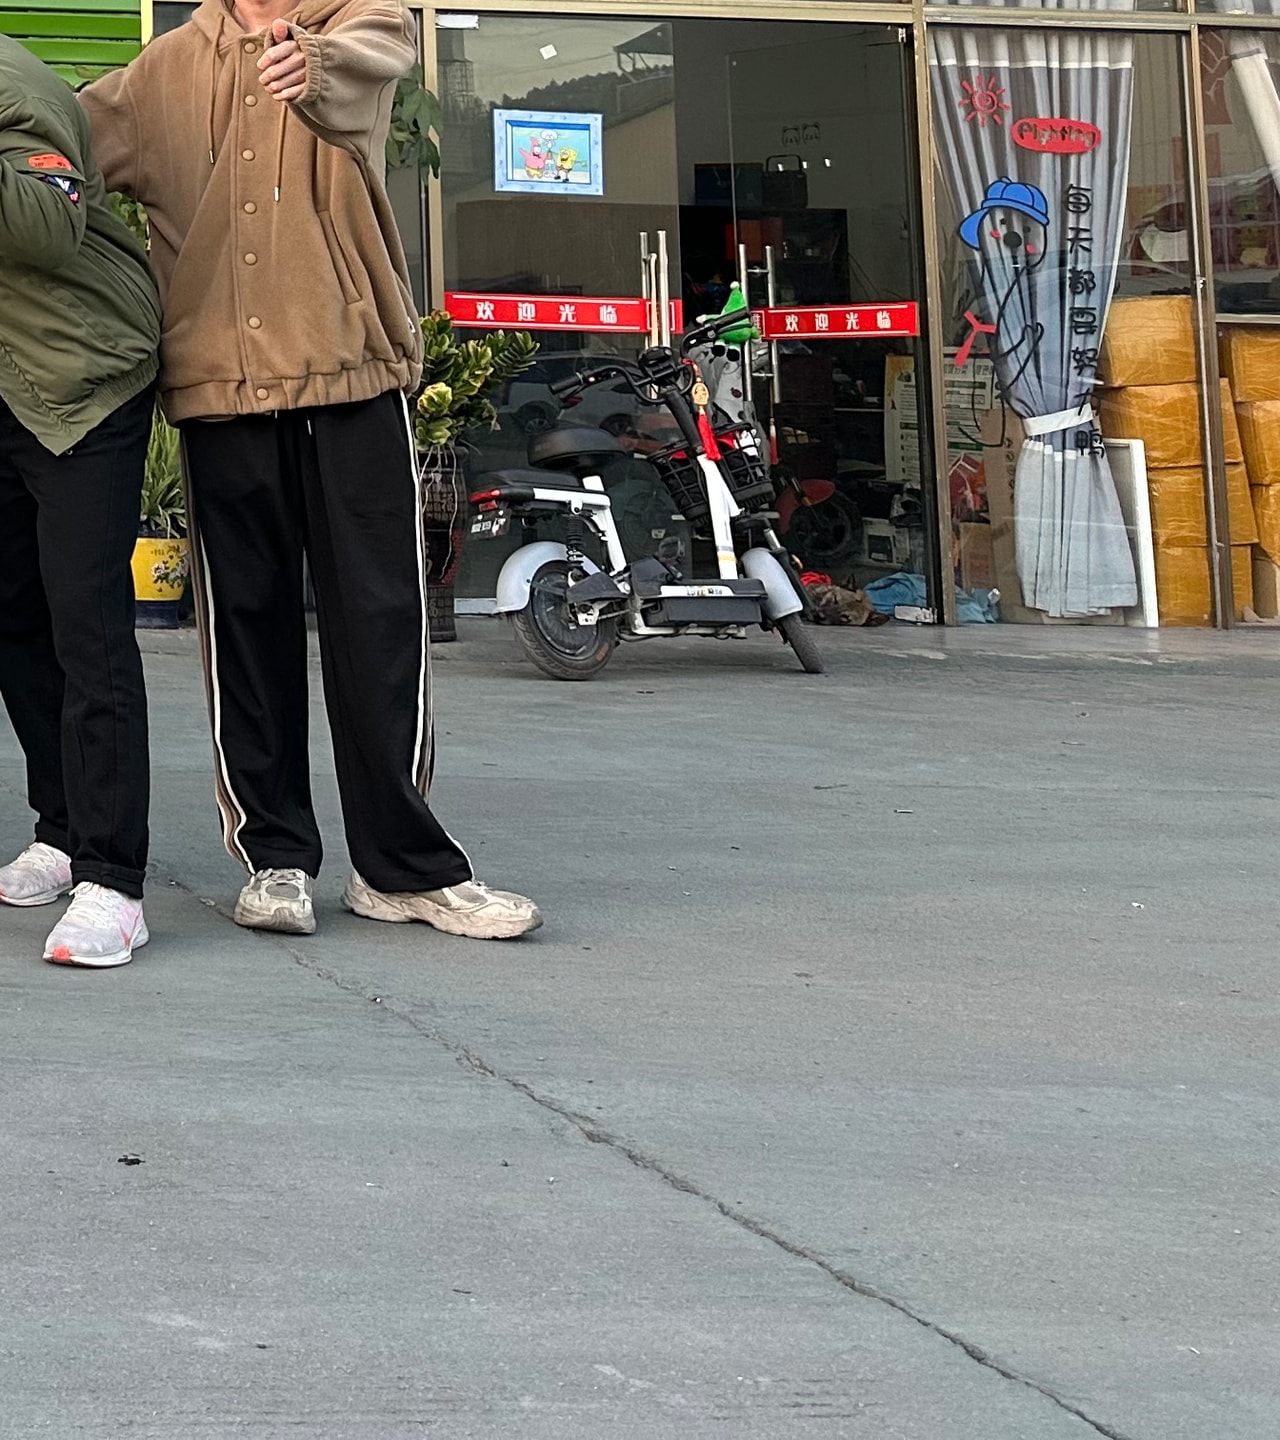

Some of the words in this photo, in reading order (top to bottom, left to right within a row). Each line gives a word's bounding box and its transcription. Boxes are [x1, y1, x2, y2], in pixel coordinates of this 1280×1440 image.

[475, 301, 618, 325] 欢迎光临
[785, 311, 893, 333] 欢迎光临
